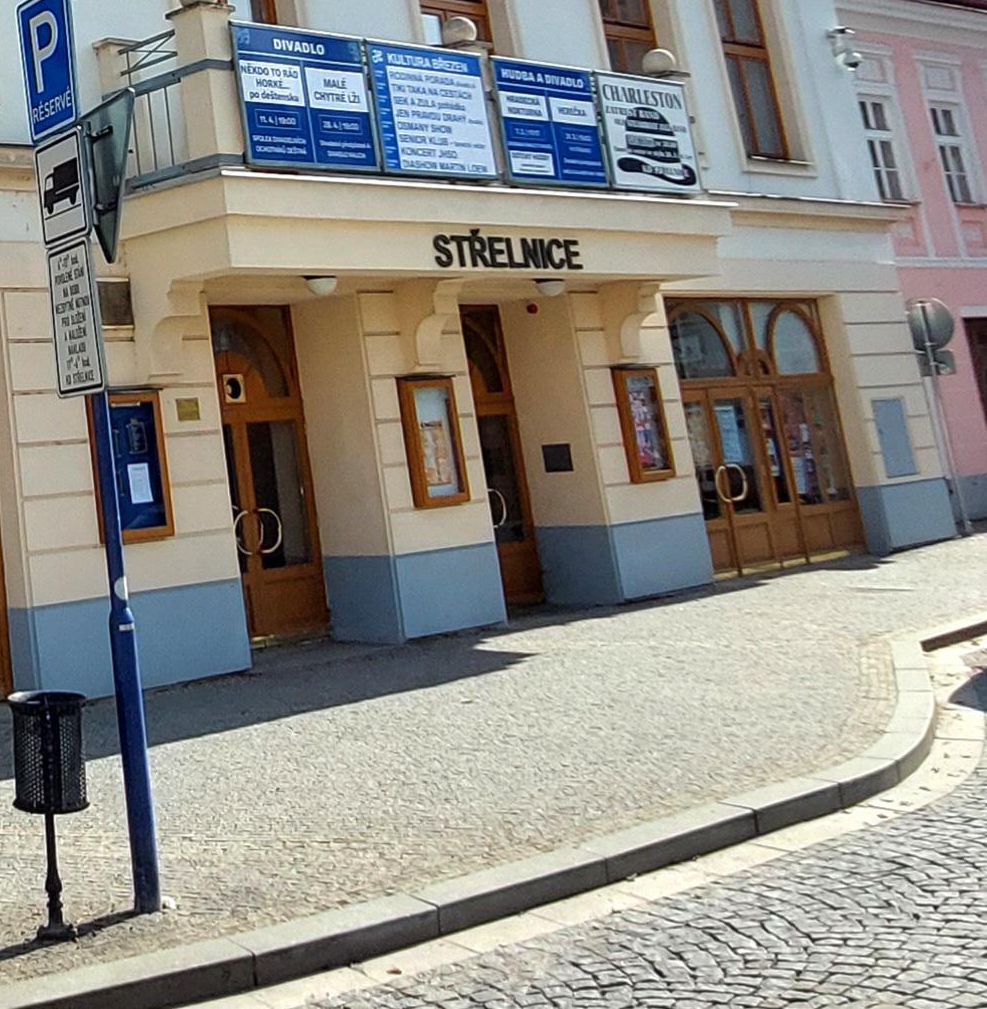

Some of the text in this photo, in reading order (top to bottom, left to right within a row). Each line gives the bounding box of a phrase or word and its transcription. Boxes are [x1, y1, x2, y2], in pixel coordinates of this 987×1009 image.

[30, 10, 58, 94] P
[273, 38, 324, 55] DIVADLO
[387, 53, 431, 68] KULTURA
[240, 64, 268, 76] NĚKDO
[272, 68, 281, 77] TO
[323, 78, 348, 89] MALÉ
[537, 74, 544, 84] A
[545, 75, 584, 89] DIVADLO
[250, 91, 260, 100] po
[314, 91, 346, 102] CHYTRÉ
[407, 85, 426, 95] TAKA
[428, 87, 438, 96] NA
[602, 84, 682, 110] CHARLESTON
[32, 86, 72, 124] RÉSERVÉ
[398, 134, 426, 144] SENIOR
[401, 147, 436, 158] KONCERT
[432, 228, 584, 270] STŘELNICE
